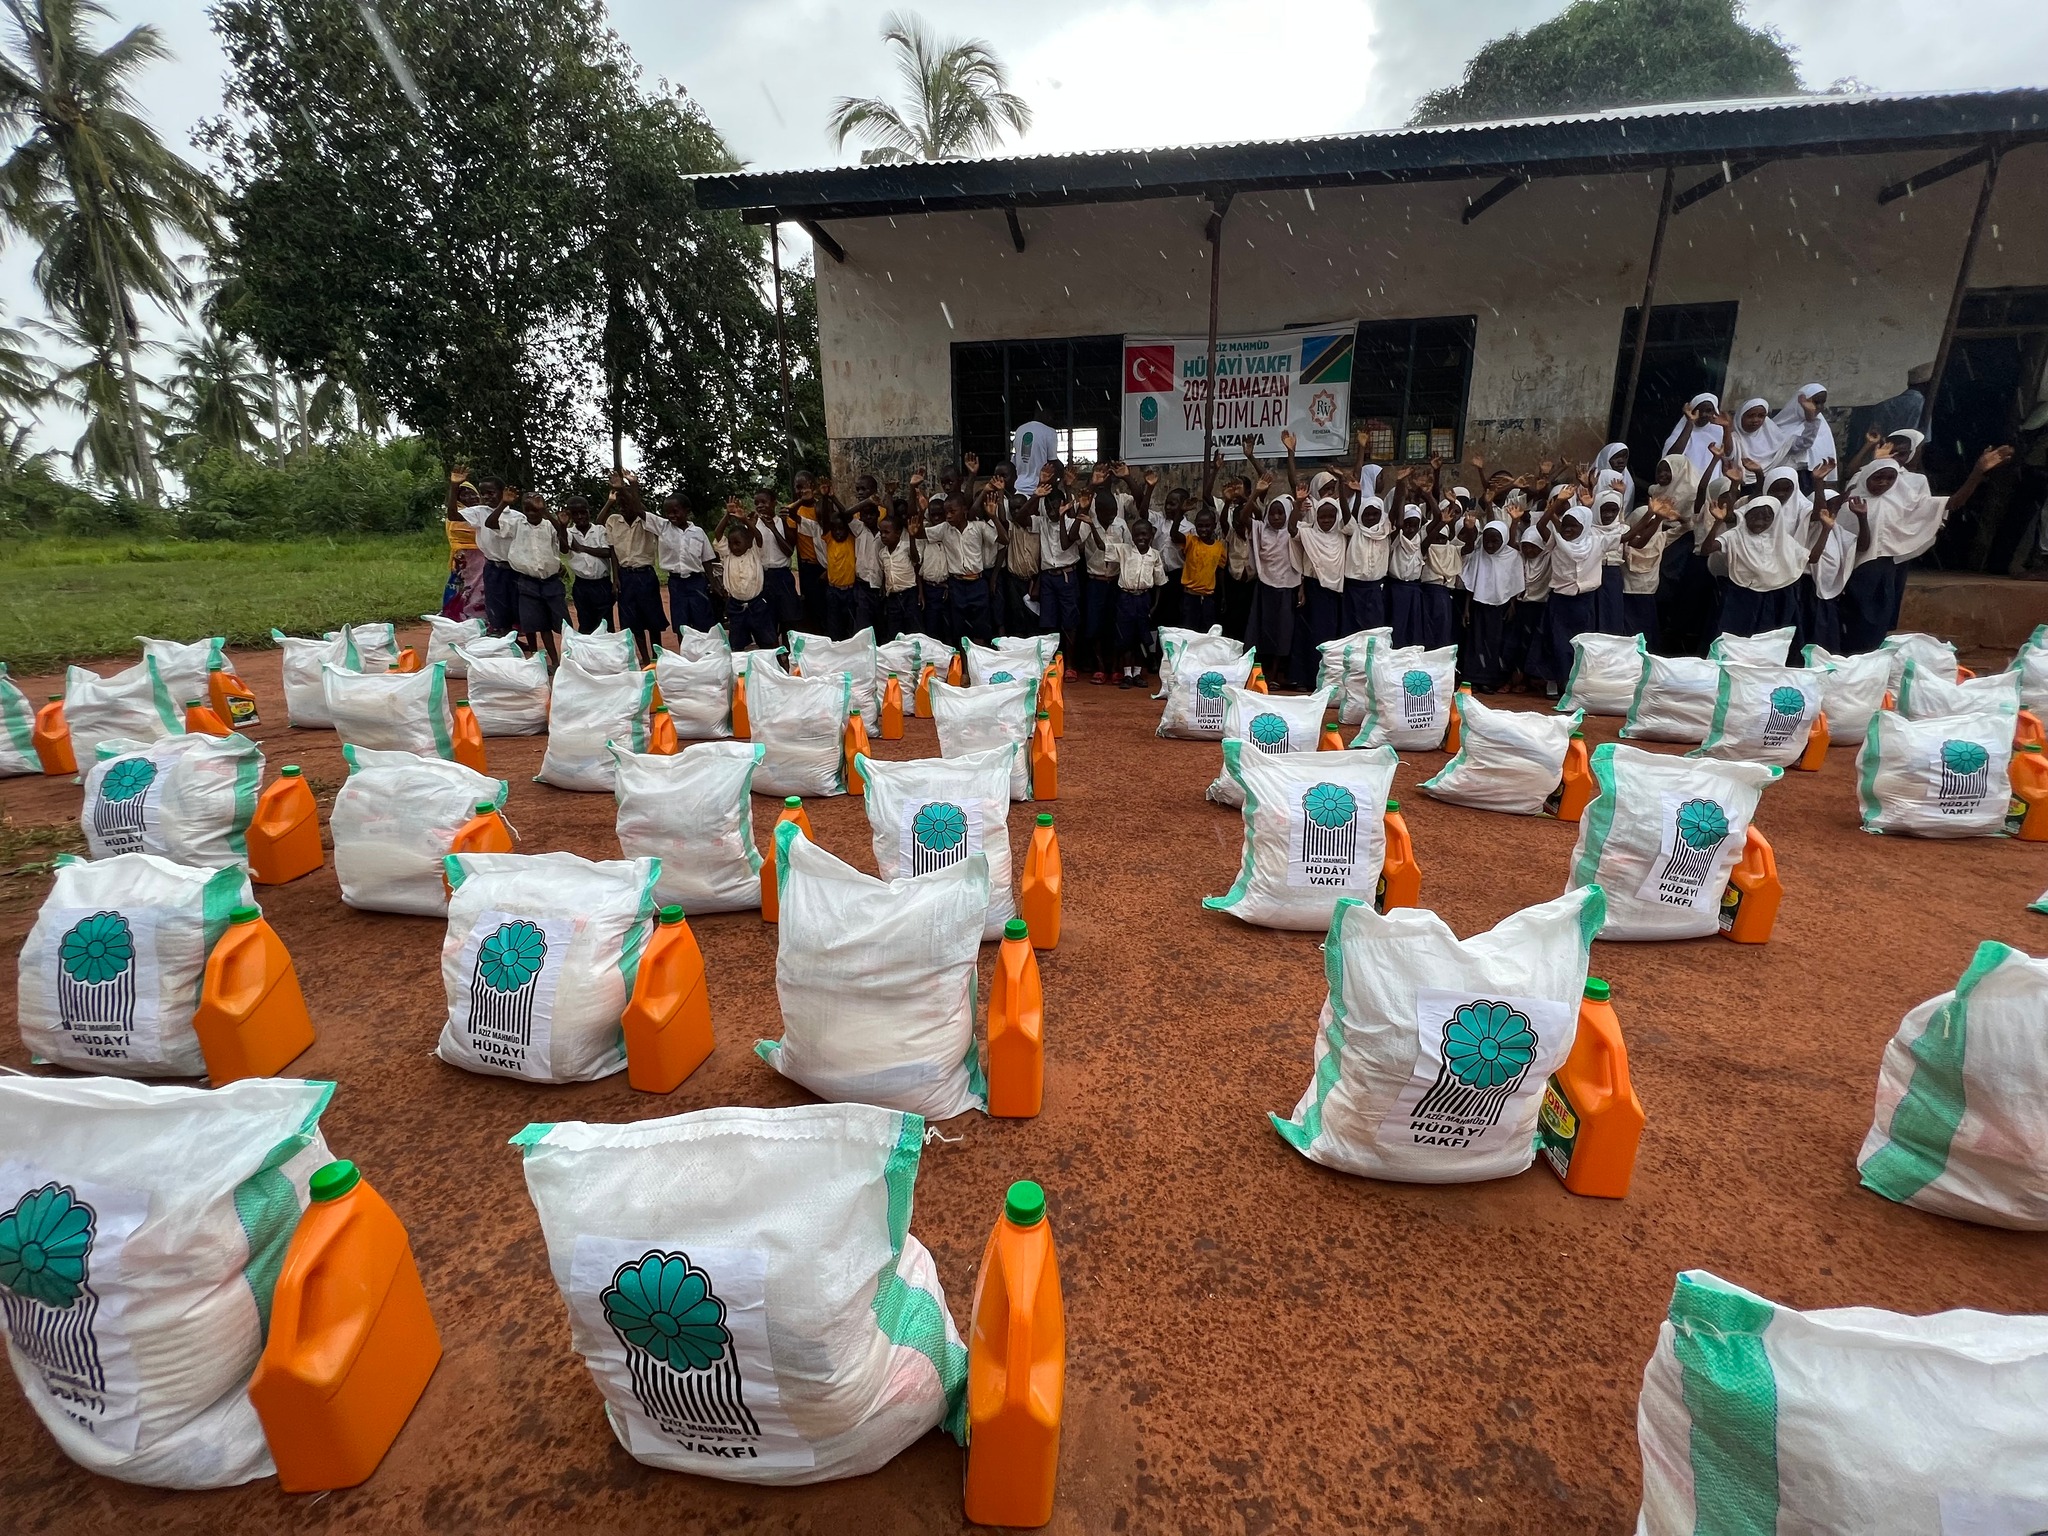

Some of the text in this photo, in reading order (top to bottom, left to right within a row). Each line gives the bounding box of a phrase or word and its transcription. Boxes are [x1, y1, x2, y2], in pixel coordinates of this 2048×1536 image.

[1207, 339, 1270, 352] ZİZ MAHMÛD
[1183, 354, 1293, 378] HÜÂYİ VAKFI
[1183, 374, 1290, 401] 202 RAMAZAN
[1183, 398, 1289, 431] YADIMLARI
[1204, 432, 1266, 448] ANZAA
[1305, 864, 1351, 876] HÜDÂYİ
[1309, 876, 1345, 886] VAKFI
[1659, 893, 1693, 907] VAKFI
[478, 1027, 520, 1044] AZİZ MAHMÛD
[85, 1046, 128, 1058] VAKFI
[472, 1038, 526, 1060] HÜDÂYİ
[479, 1053, 522, 1071] VAKFI
[1424, 1113, 1486, 1126] AZİZ MAHMÛD
[1409, 1121, 1487, 1137] HÜDÂYİ
[1413, 1134, 1471, 1148] VAKFI
[686, 1423, 742, 1435] MAHMÛD
[676, 1439, 758, 1458] VAKFI
